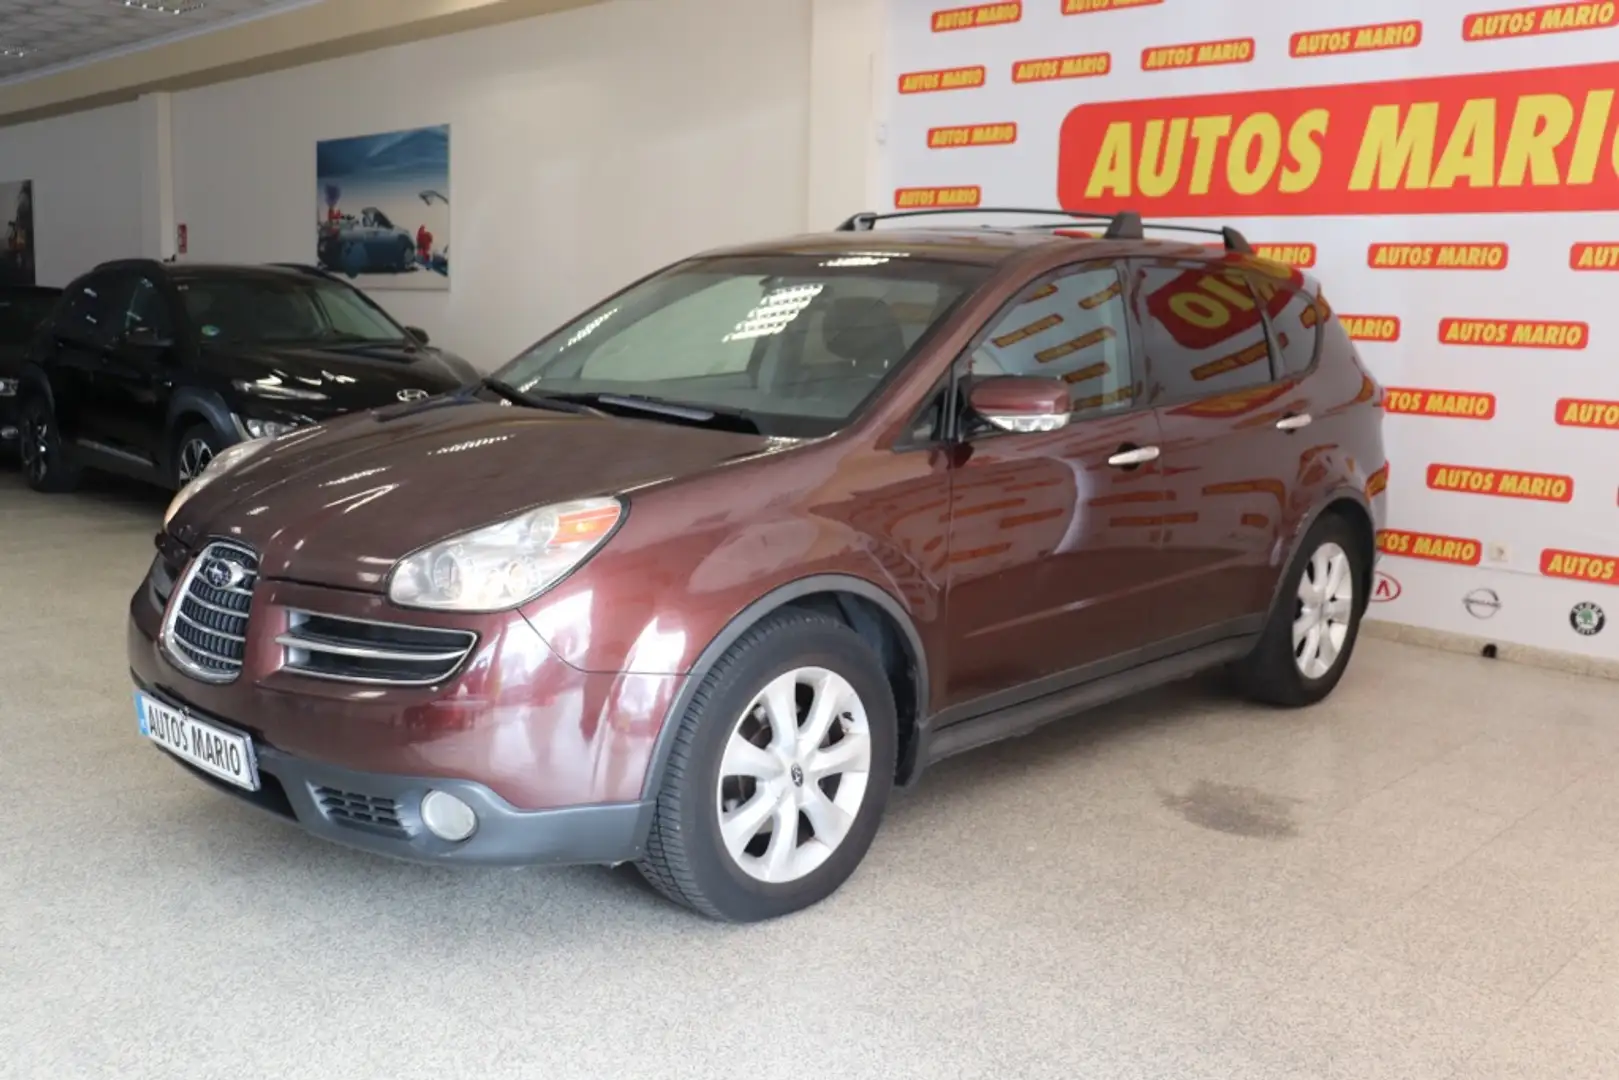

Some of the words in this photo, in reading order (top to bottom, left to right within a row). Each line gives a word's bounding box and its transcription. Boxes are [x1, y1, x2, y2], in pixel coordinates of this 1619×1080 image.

[935, 11, 974, 30] AUTOS
[976, 3, 1019, 25] MARIO
[1470, 11, 1537, 37] AUTOS
[1540, 2, 1616, 29] MARIO
[1295, 32, 1352, 55] AUTOS
[1355, 24, 1417, 49] MARIO
[1145, 46, 1195, 68] AUTOS
[1196, 41, 1251, 65] MARIO
[902, 73, 940, 91] AUTOS
[941, 68, 983, 88] MARIO
[1016, 60, 1058, 80] AUTOS
[1060, 55, 1108, 76] MARIO
[931, 130, 970, 146] AUTOS
[971, 125, 1014, 144] MARIO
[1085, 108, 1330, 198] AUTOS
[1348, 88, 1619, 192] MARI
[898, 190, 935, 206] AUTOS
[936, 188, 978, 205] MARIO
[1374, 246, 1433, 266] AUTOS
[1435, 246, 1503, 267] MARIO
[1577, 245, 1619, 267] AUT
[1445, 321, 1508, 343] AUTOS
[1511, 324, 1582, 347] MARIO
[1386, 391, 1422, 411] TOS
[1425, 393, 1490, 416] MARIO
[1563, 402, 1619, 425] AUTO
[1434, 468, 1495, 491] AUTOS
[1498, 474, 1567, 498] MARIO
[1412, 536, 1475, 561] MARIO
[1548, 553, 1615, 580] AUTOS
[148, 704, 188, 752] AUTOS
[191, 725, 241, 776] MARIO
